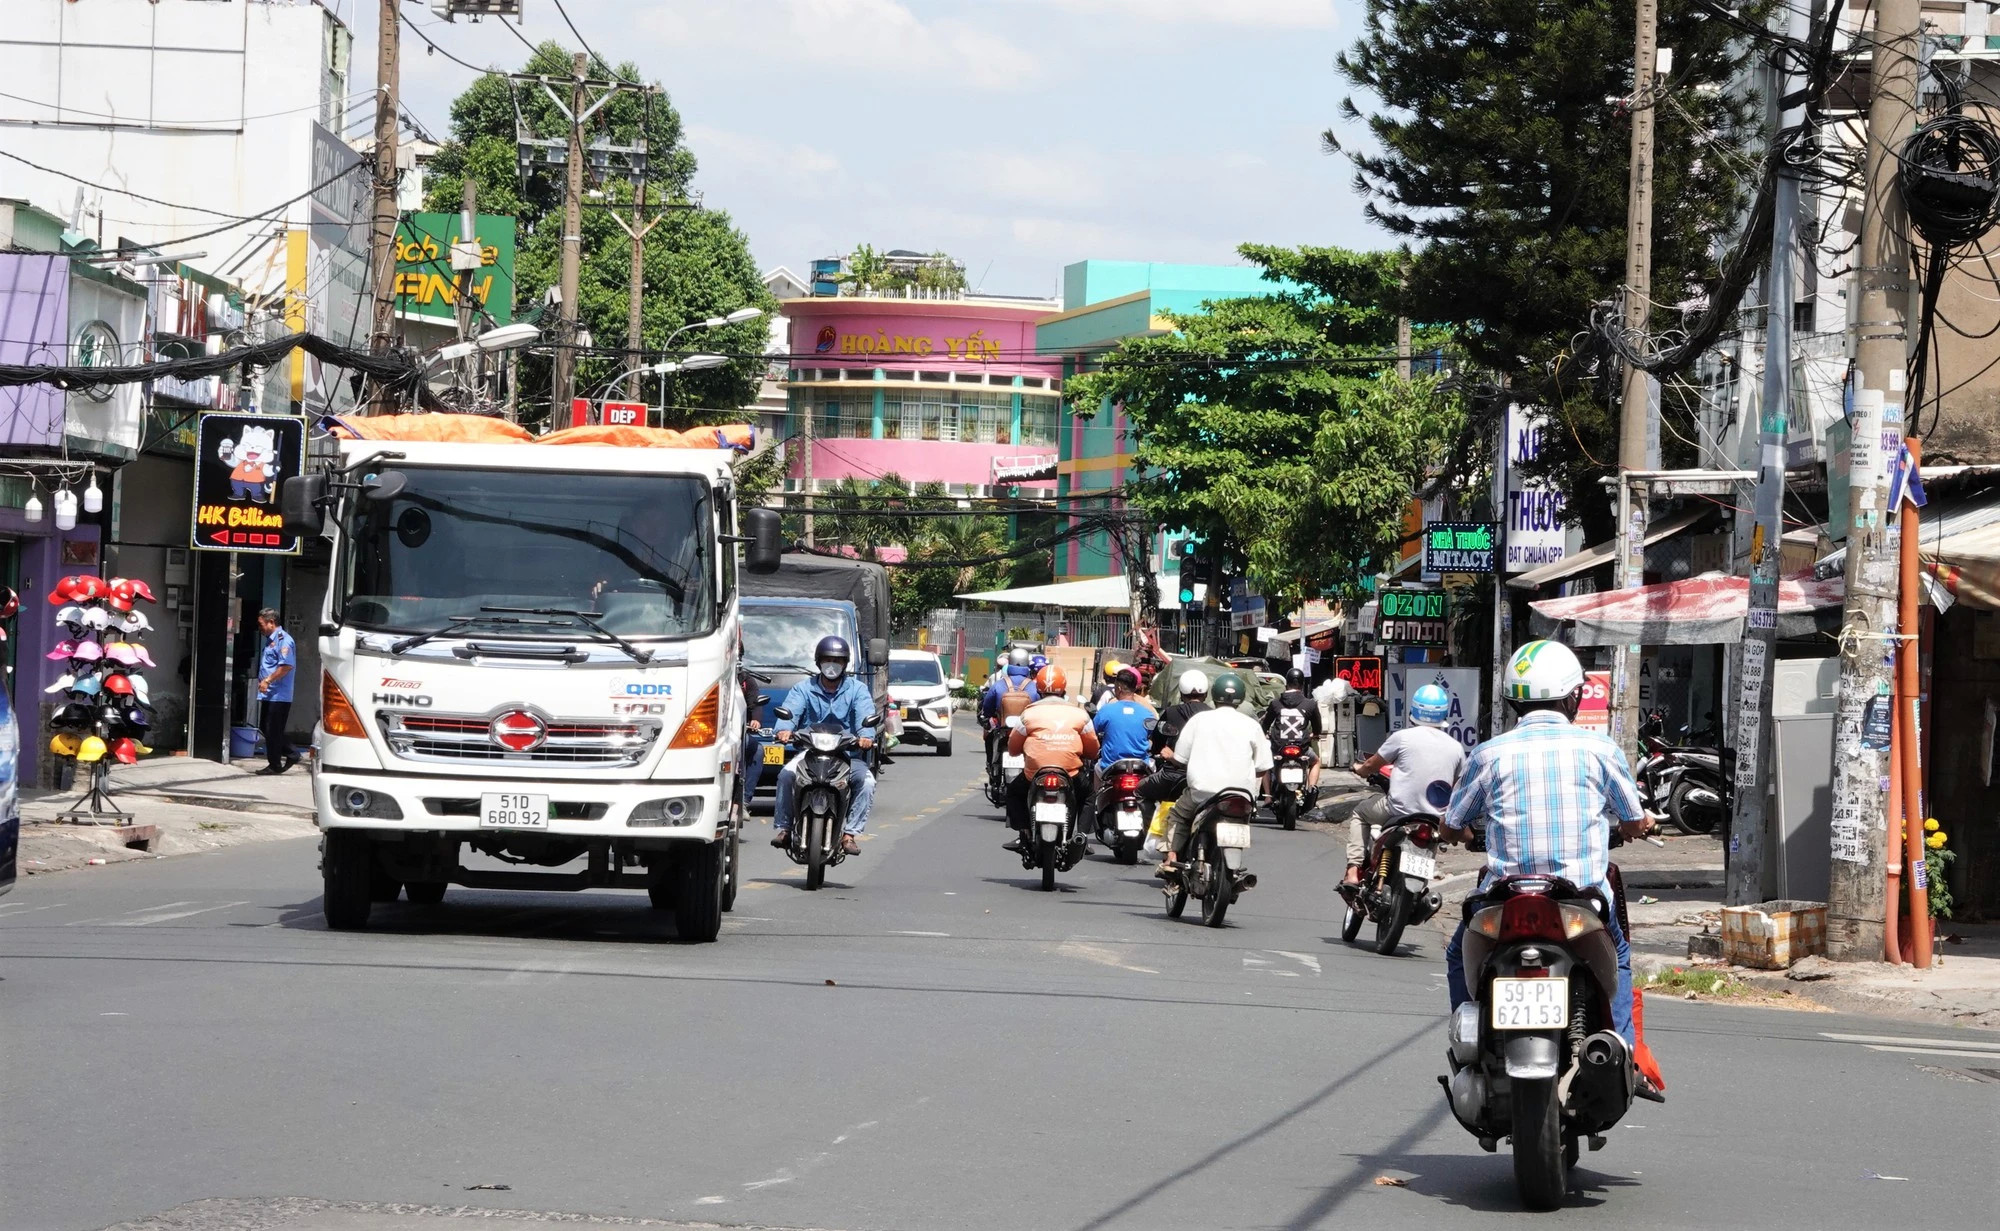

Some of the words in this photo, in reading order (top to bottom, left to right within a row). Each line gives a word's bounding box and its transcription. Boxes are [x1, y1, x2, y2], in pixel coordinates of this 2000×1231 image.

[395, 272, 493, 305] ANH
[840, 328, 932, 357] HOÀNG
[944, 329, 1001, 361] YẾN
[610, 407, 637, 424] DÉP
[1519, 428, 1542, 464] NH
[198, 505, 226, 524] HK
[1432, 527, 1454, 549] NHÀ
[1456, 525, 1491, 549] THUỐC
[1432, 551, 1490, 568] MITACY
[1508, 546, 1521, 566] ĐẠT
[1523, 539, 1547, 564] CHUẨN
[1548, 546, 1563, 563] GPP
[1383, 593, 1442, 617] OZON
[381, 677, 423, 689] TURBO
[626, 683, 672, 695] QDR
[1575, 684, 1606, 699] OS
[372, 692, 433, 707] HINO
[501, 795, 529, 809] 51D
[488, 810, 541, 825] 680.92
[1504, 982, 1553, 1003] 59-P1
[1498, 1005, 1563, 1025] 621.53
